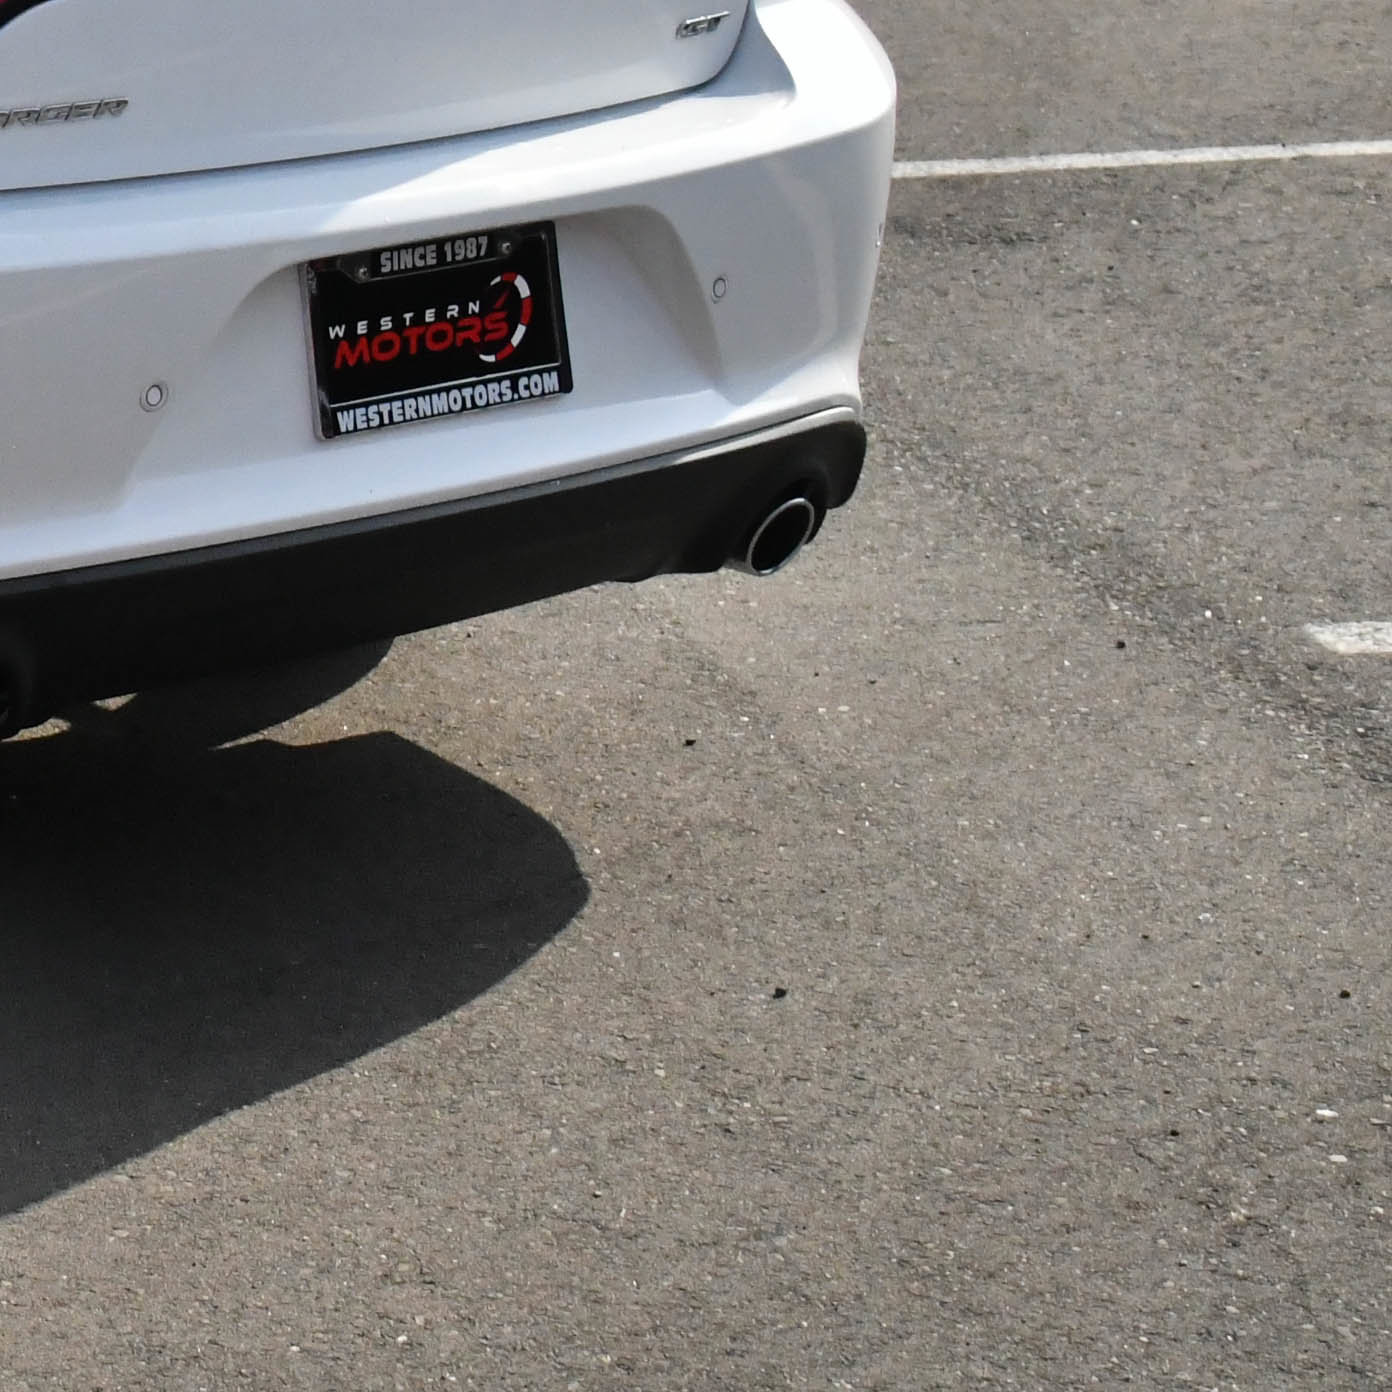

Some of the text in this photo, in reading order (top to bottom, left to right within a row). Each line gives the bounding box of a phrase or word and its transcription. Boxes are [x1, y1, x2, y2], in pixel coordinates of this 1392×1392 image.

[675, 10, 731, 40] GT
[380, 236, 488, 273] SINCE 1987
[328, 300, 480, 340] WESTERN
[333, 310, 510, 369] MOTORS
[336, 371, 560, 434] WESTERNMOTORS.COM
